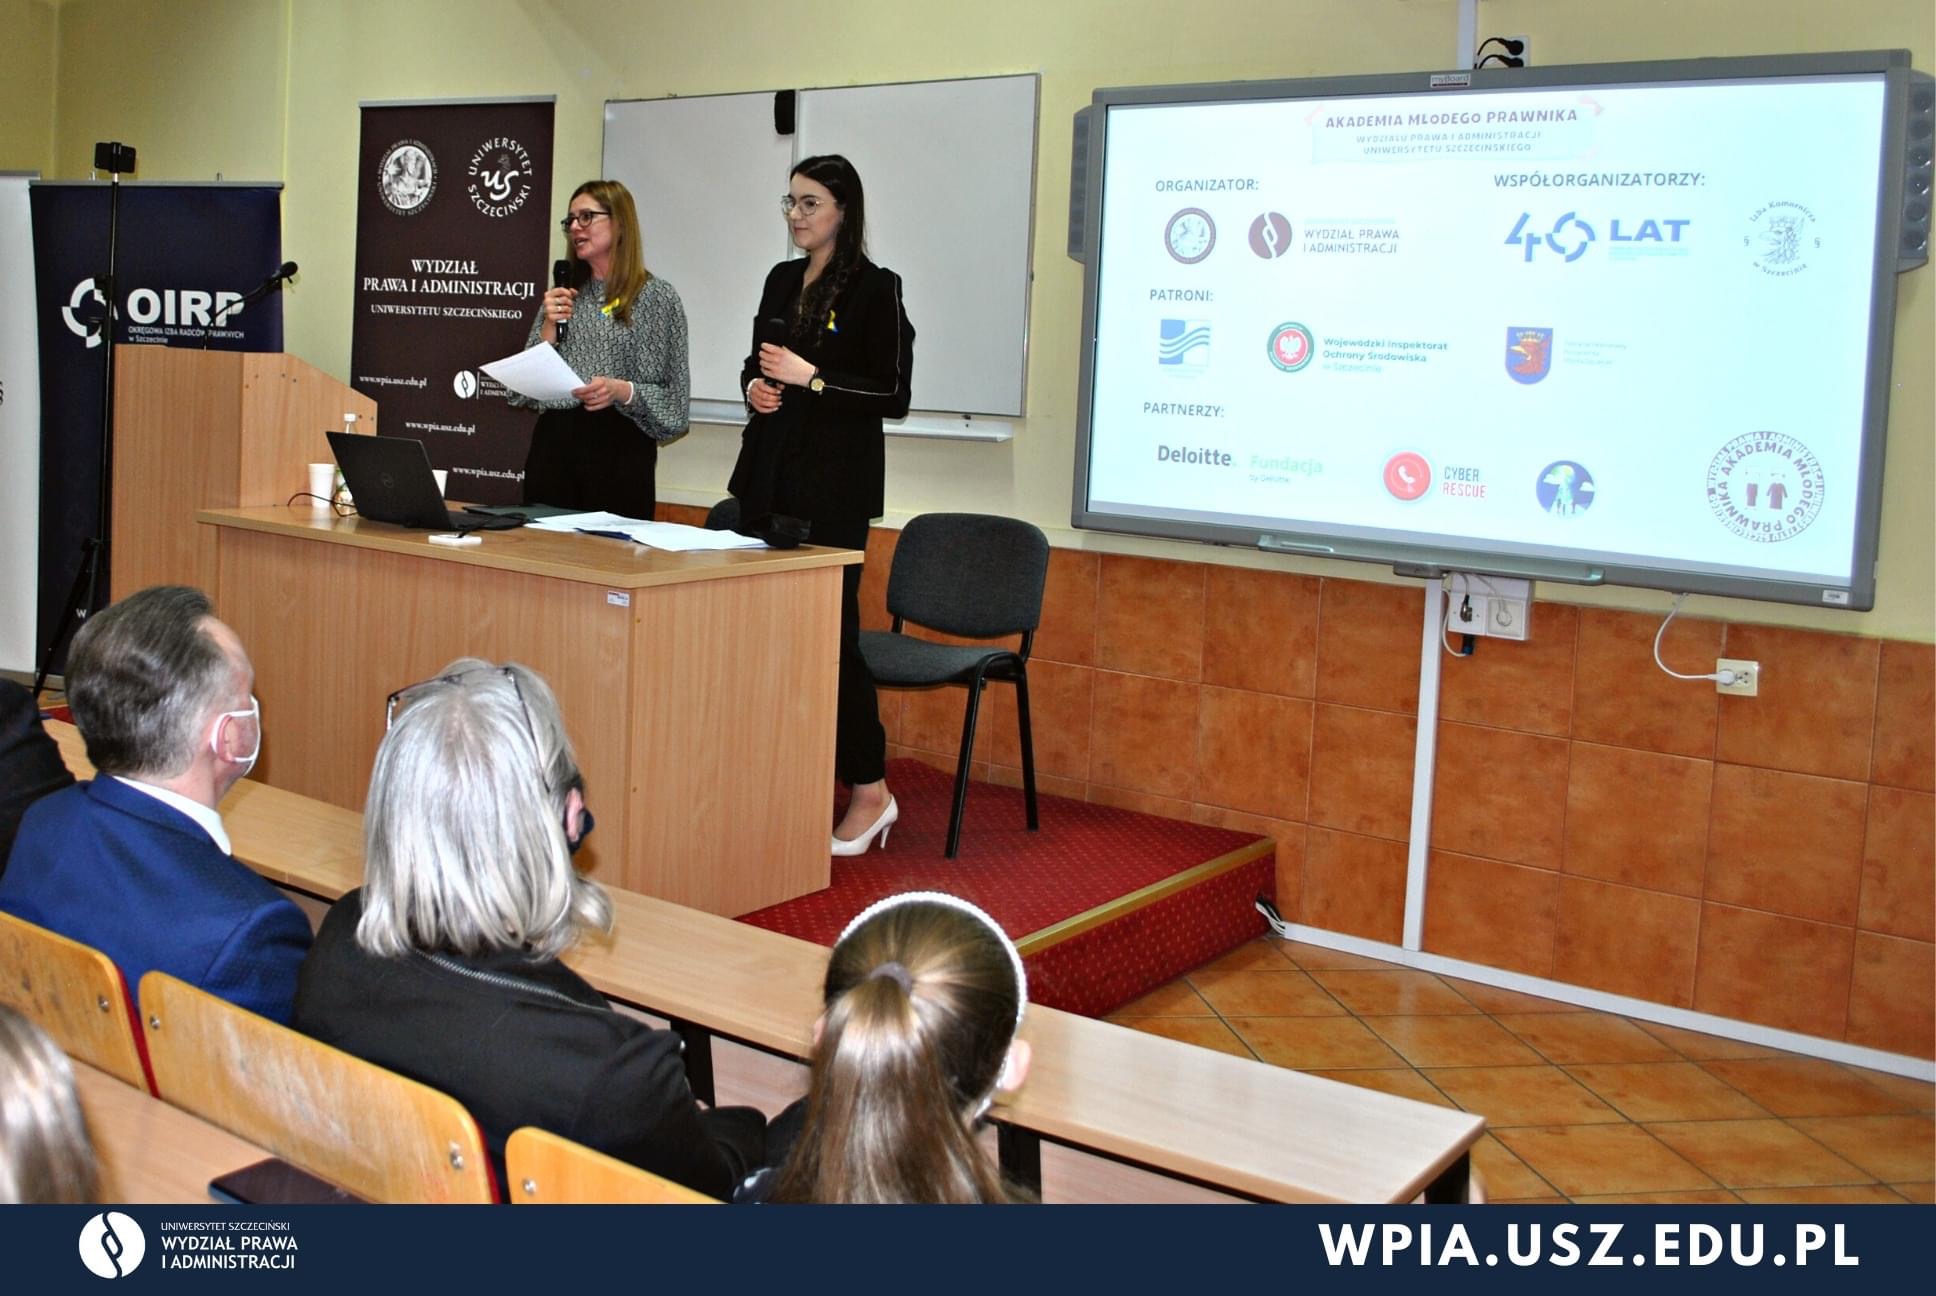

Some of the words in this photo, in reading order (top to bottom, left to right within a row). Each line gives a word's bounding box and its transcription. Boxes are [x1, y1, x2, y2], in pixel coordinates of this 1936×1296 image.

[1326, 114, 1403, 128] AKADEMIA
[1486, 109, 1578, 123] PRAWNIKA
[468, 137, 533, 176] UNIWERSYTET
[1155, 178, 1259, 192] ORGANIZATOR:
[1494, 170, 1706, 187] WSPÓŁORGANIZATORZY:
[1359, 229, 1400, 240] PRAWA
[1610, 219, 1690, 242] LAT
[1310, 243, 1397, 254] ADMINISTRACJI
[411, 259, 479, 275] WYDZIAŁ
[363, 277, 408, 292] PRAWA
[411, 278, 416, 293] I
[420, 279, 536, 300] ADMINISTRACJI
[1149, 289, 1213, 302] PATRONI:
[127, 287, 245, 327] OIRP
[370, 304, 441, 316] UNIWERSYTETU
[443, 305, 523, 319] SZCZECIŃSKIEGO
[1322, 350, 1365, 360] Ochrony
[359, 375, 427, 389] www.wpia.usz.edu.pl
[1143, 401, 1225, 417] PARTNERZY:
[405, 421, 476, 436] www.wpia.usz.edu.pl
[1250, 455, 1323, 477] Fundacja
[1721, 441, 1793, 476] AKADEMIA
[452, 465, 525, 481] www.wpia.usz.edu.pl
[1444, 466, 1480, 482] CYBER
[1442, 482, 1487, 498] RESCUE
[1718, 481, 1783, 533] PRAWNIKA
